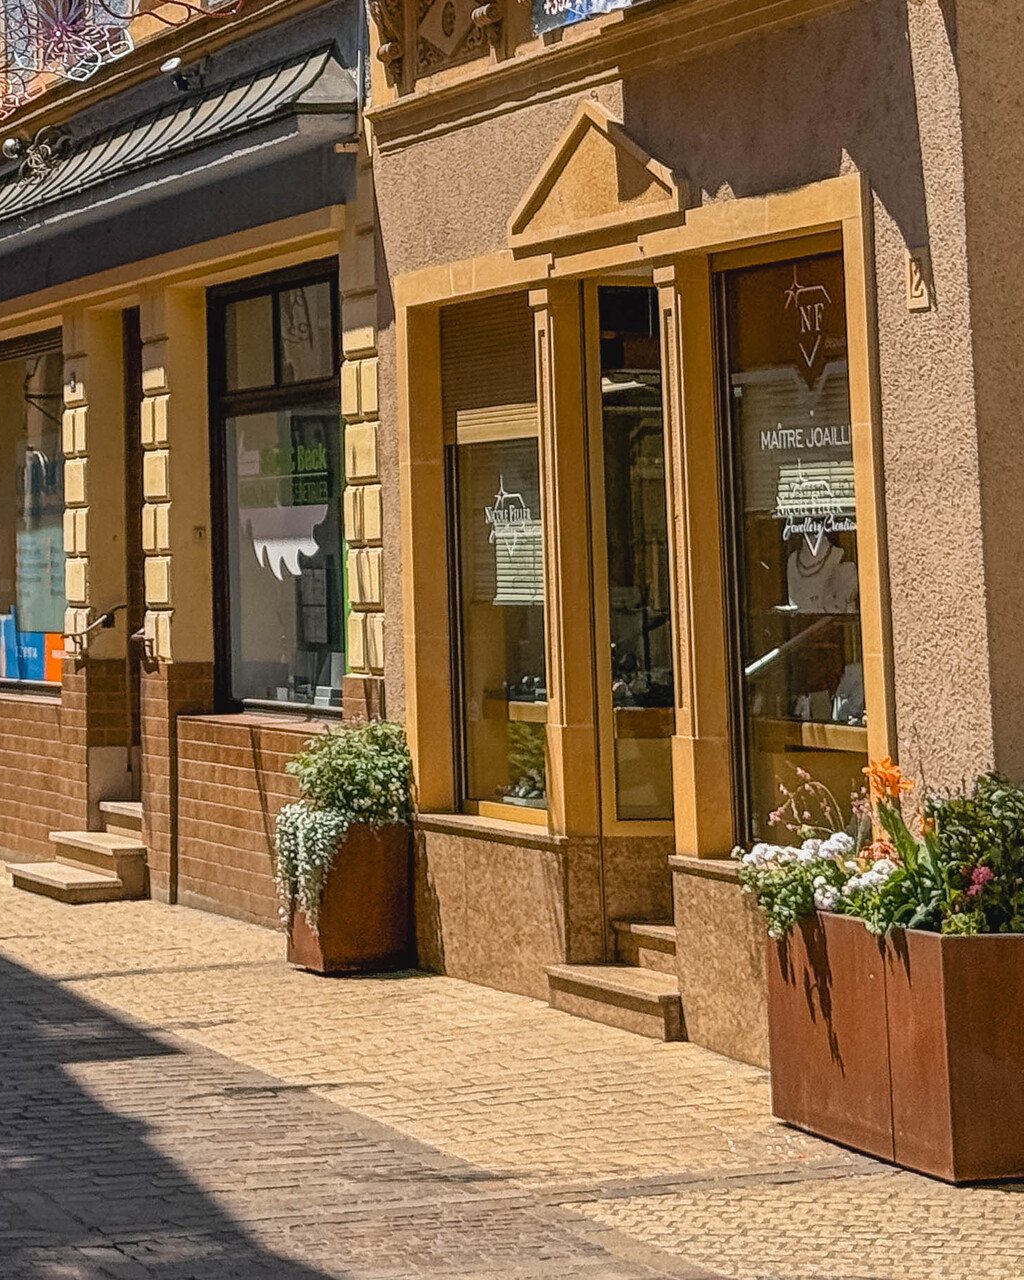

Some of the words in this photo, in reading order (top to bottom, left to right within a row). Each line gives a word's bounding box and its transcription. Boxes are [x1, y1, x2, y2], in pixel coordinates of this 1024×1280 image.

[798, 303, 825, 334] NF
[760, 422, 805, 451] MAÎTRE
[806, 424, 851, 448] JOAILLI
